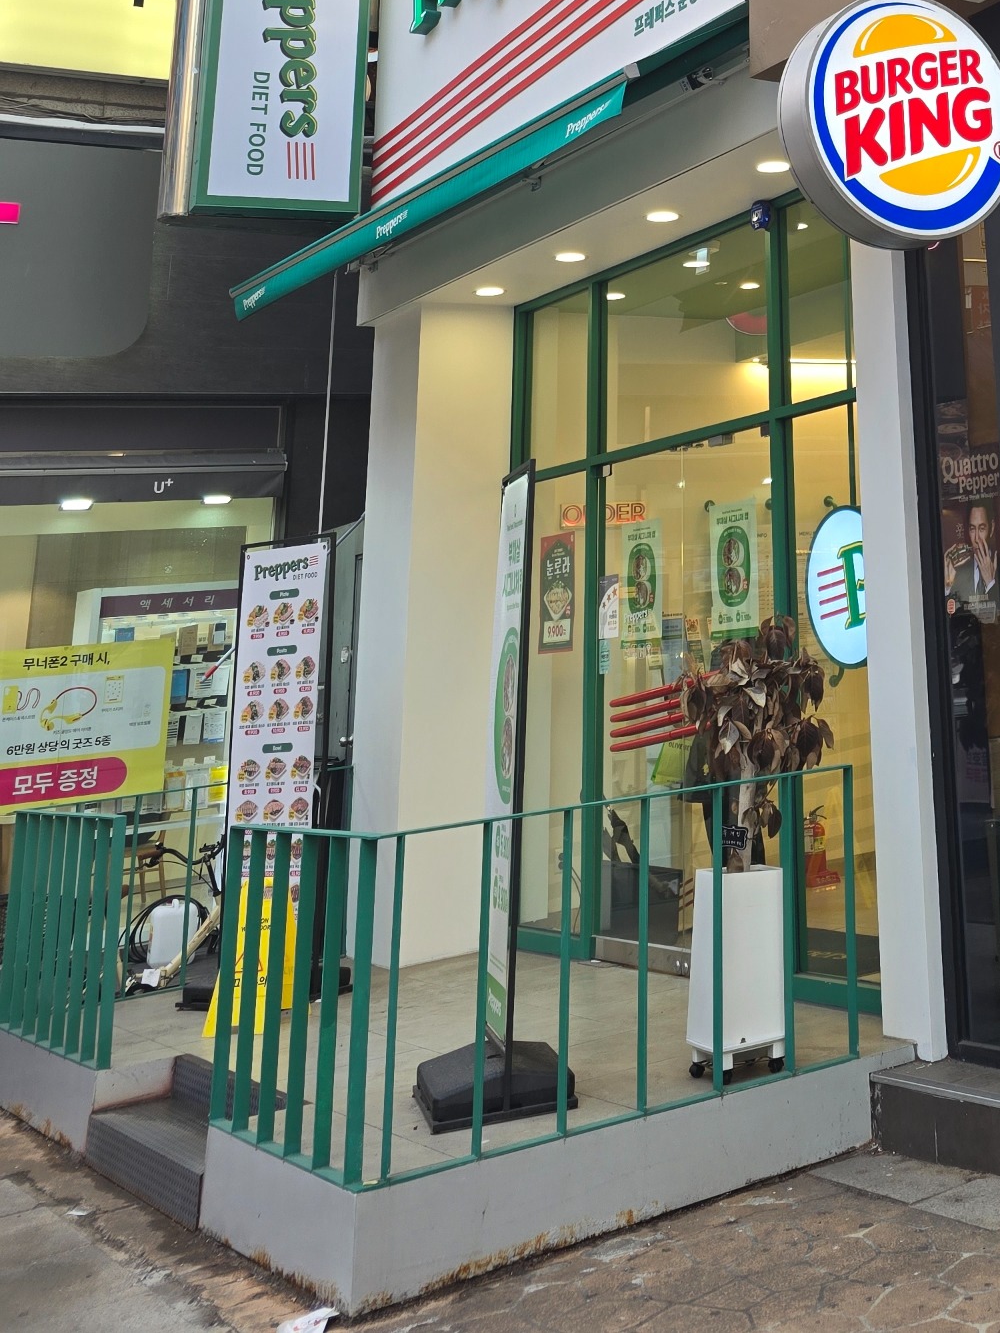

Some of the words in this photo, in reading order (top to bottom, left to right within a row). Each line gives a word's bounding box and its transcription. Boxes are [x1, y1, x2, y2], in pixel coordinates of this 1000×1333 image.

[634, 0, 676, 37] 프레퍼스
[251, 71, 270, 115] DIET
[834, 47, 984, 117] BURGER
[565, 103, 606, 138] Preppers
[842, 87, 995, 180] KING
[247, 122, 267, 176] FOOD
[375, 212, 404, 239] Preppers
[942, 452, 999, 485] Quattro
[959, 472, 1000, 495] Pepper
[153, 478, 174, 494] U+
[562, 502, 646, 525] ODER
[254, 557, 309, 581] Preppers
[23, 656, 67, 671] 무너폰2
[70, 654, 94, 667] 구매
[95, 652, 110, 665] 시,
[6, 742, 36, 756] 6만원
[37, 738, 70, 753] 상당의
[73, 737, 93, 749] 굿즈
[94, 735, 112, 747] 5종
[12, 772, 54, 796] 모두
[57, 766, 98, 791] 증정
